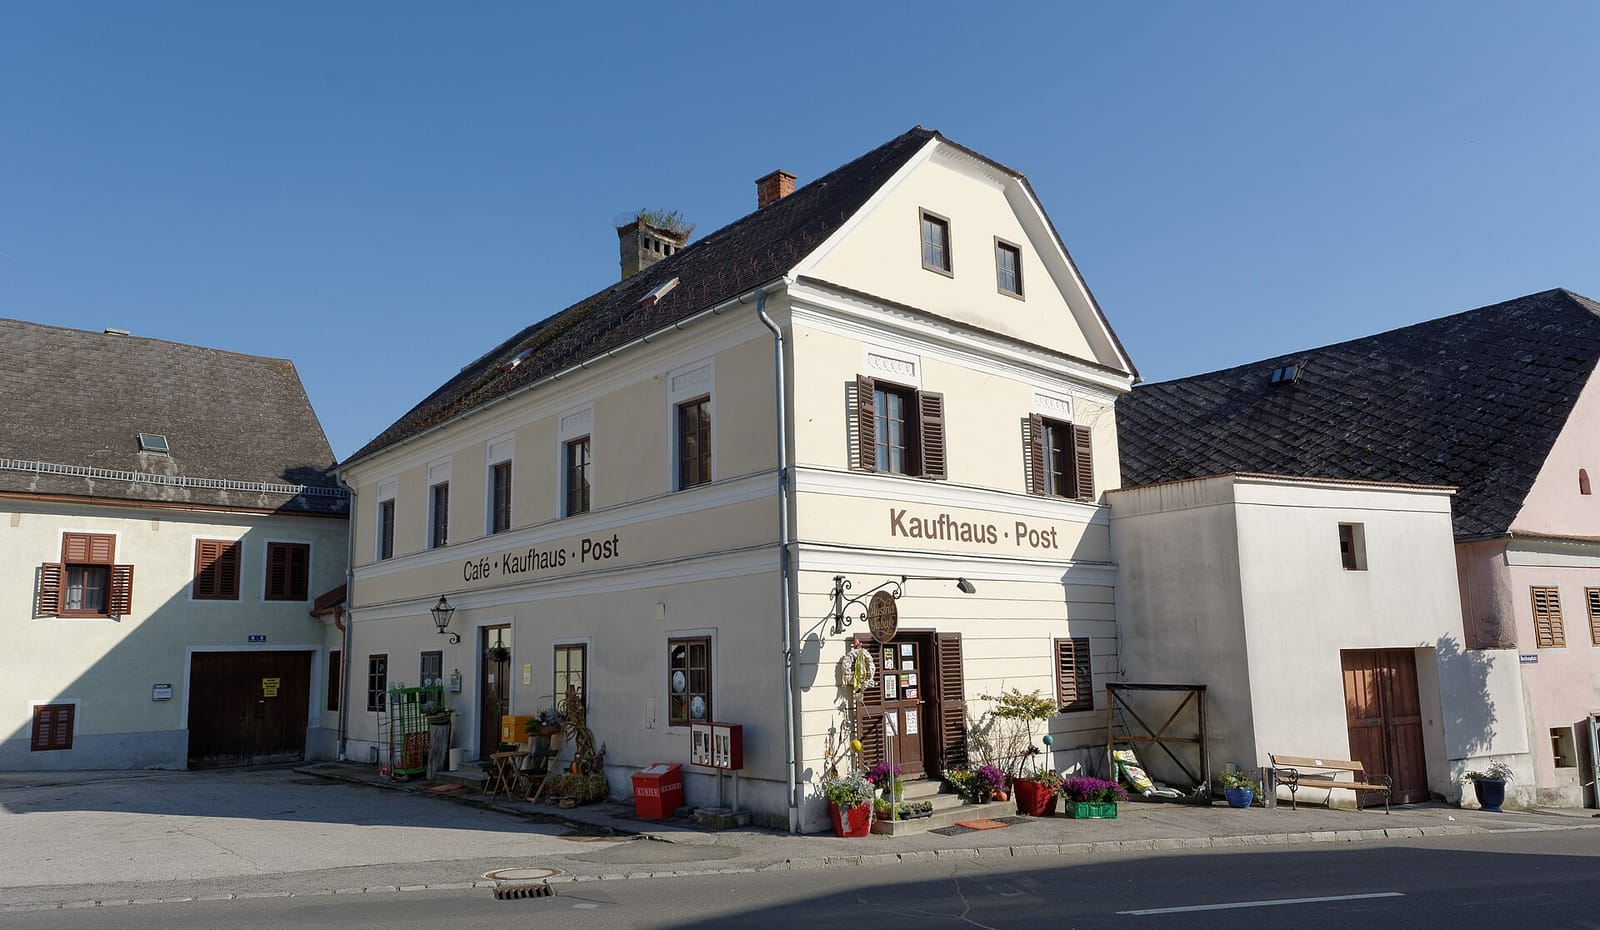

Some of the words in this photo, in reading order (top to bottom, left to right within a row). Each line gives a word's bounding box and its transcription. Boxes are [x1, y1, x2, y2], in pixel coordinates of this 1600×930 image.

[890, 508, 998, 545] Kaufhaus
[1015, 521, 1059, 550] Post
[463, 557, 491, 582] Café
[502, 548, 567, 576] Kaufhaus
[581, 534, 619, 563] Post
